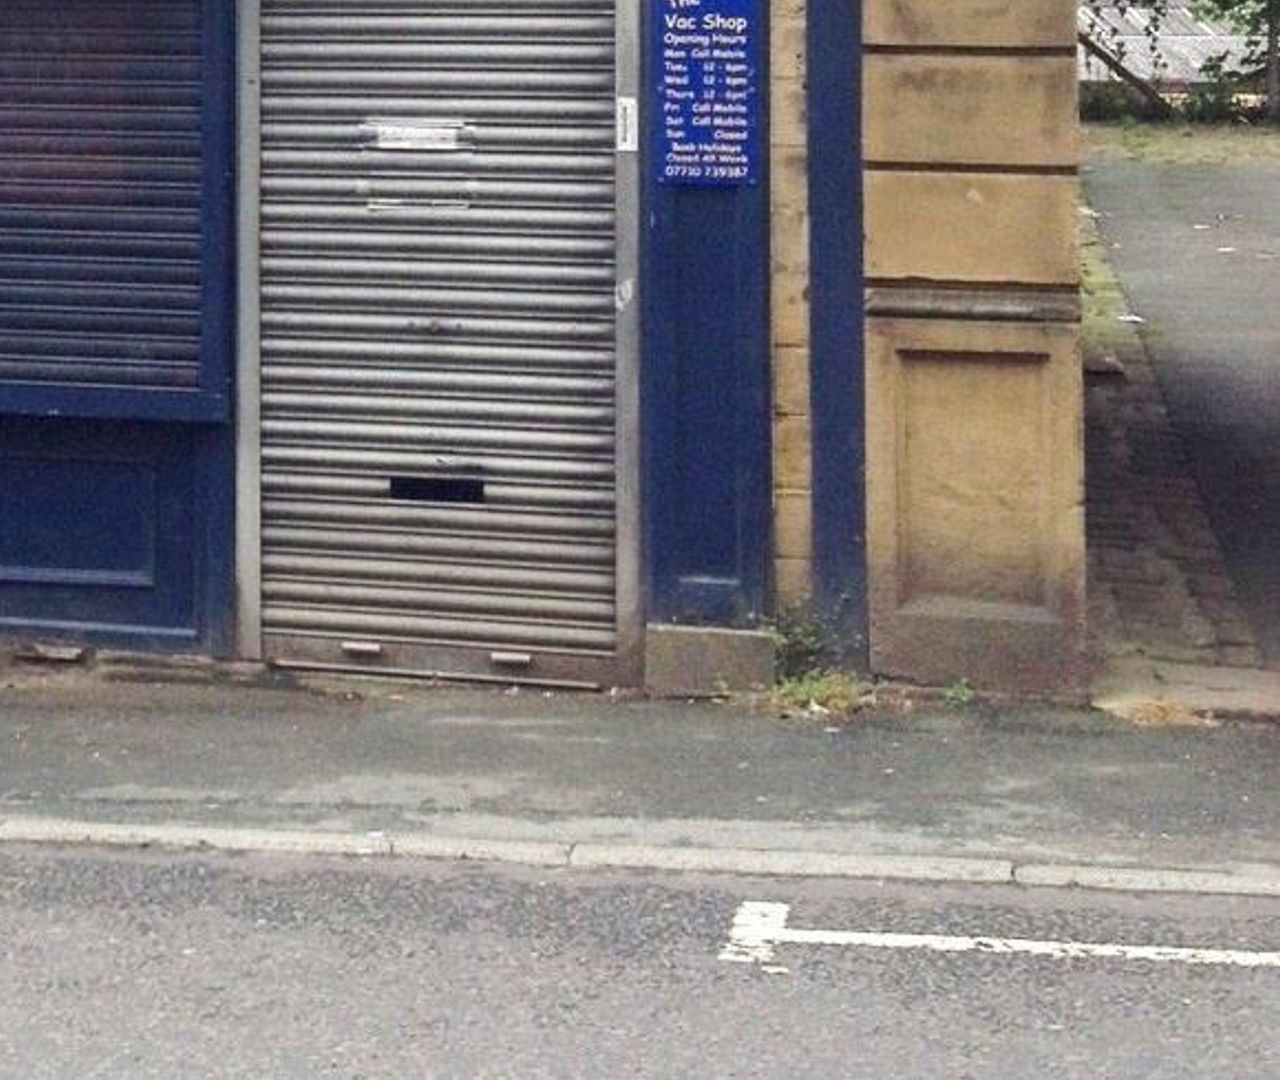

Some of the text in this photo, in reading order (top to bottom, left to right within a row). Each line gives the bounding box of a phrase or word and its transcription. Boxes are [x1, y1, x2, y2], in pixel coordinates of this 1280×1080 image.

[664, 13, 748, 34] Vac Shop
[663, 32, 748, 46] Opening Hours
[713, 128, 749, 140] Closed
